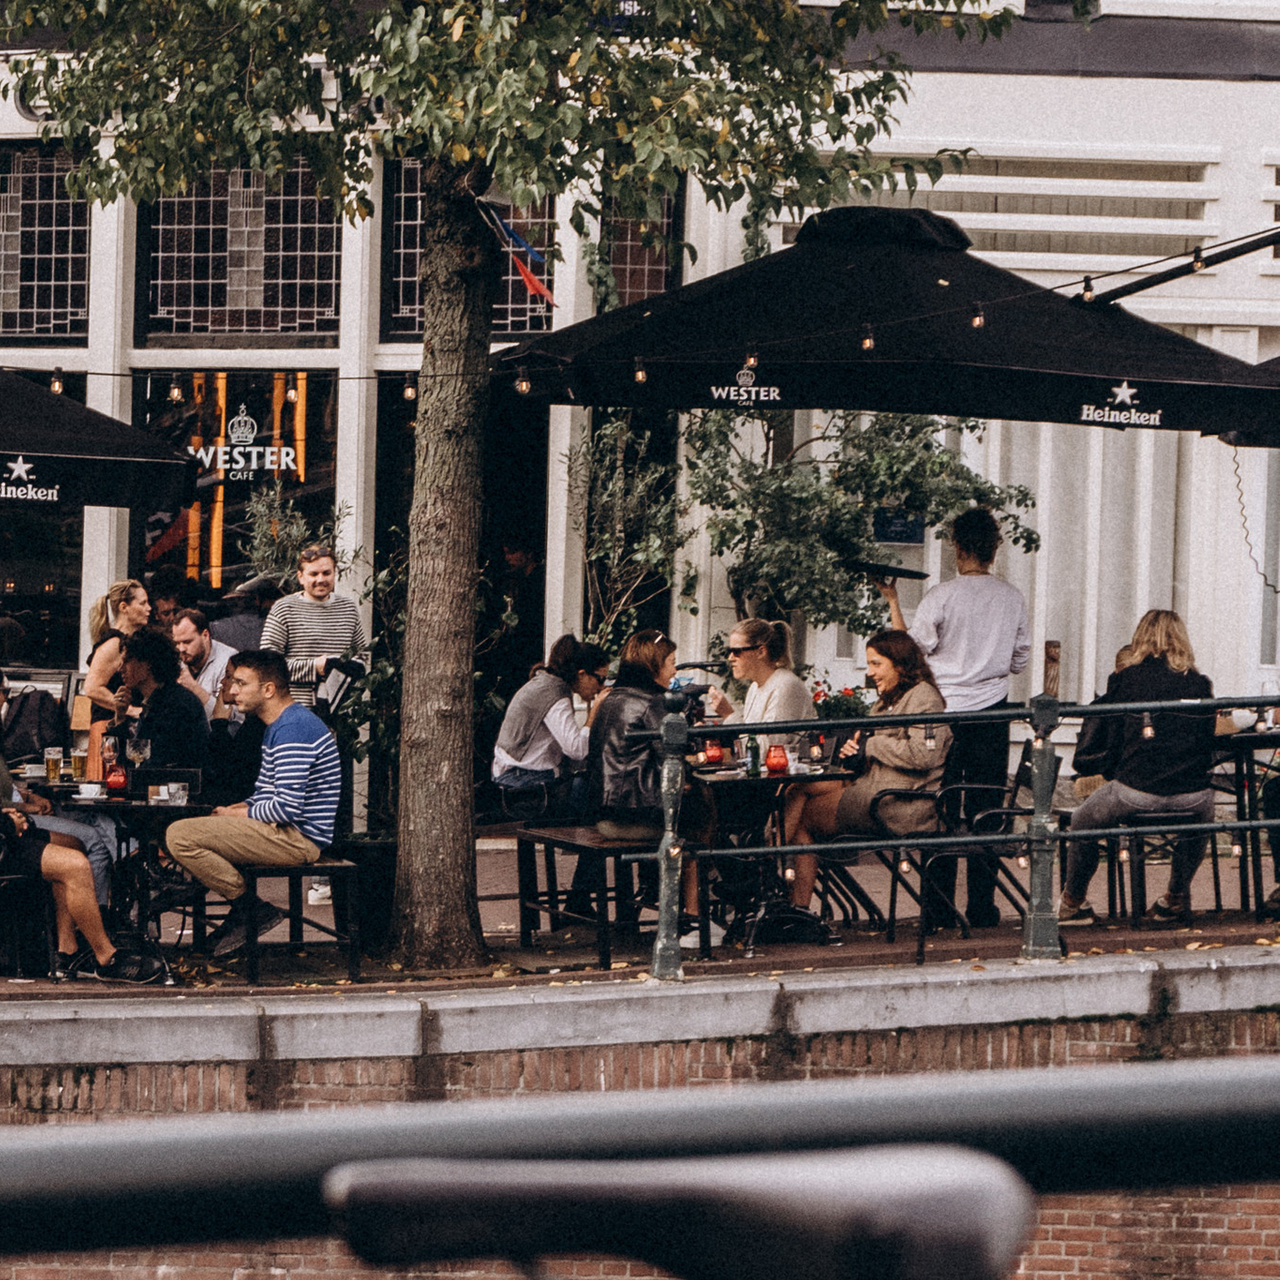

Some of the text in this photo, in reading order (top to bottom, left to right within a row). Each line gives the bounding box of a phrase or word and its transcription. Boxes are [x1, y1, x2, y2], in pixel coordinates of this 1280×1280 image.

[710, 386, 781, 400] WESTER
[1081, 404, 1162, 426] Heineken
[187, 446, 298, 470] WESTER
[229, 471, 254, 481] CAFE
